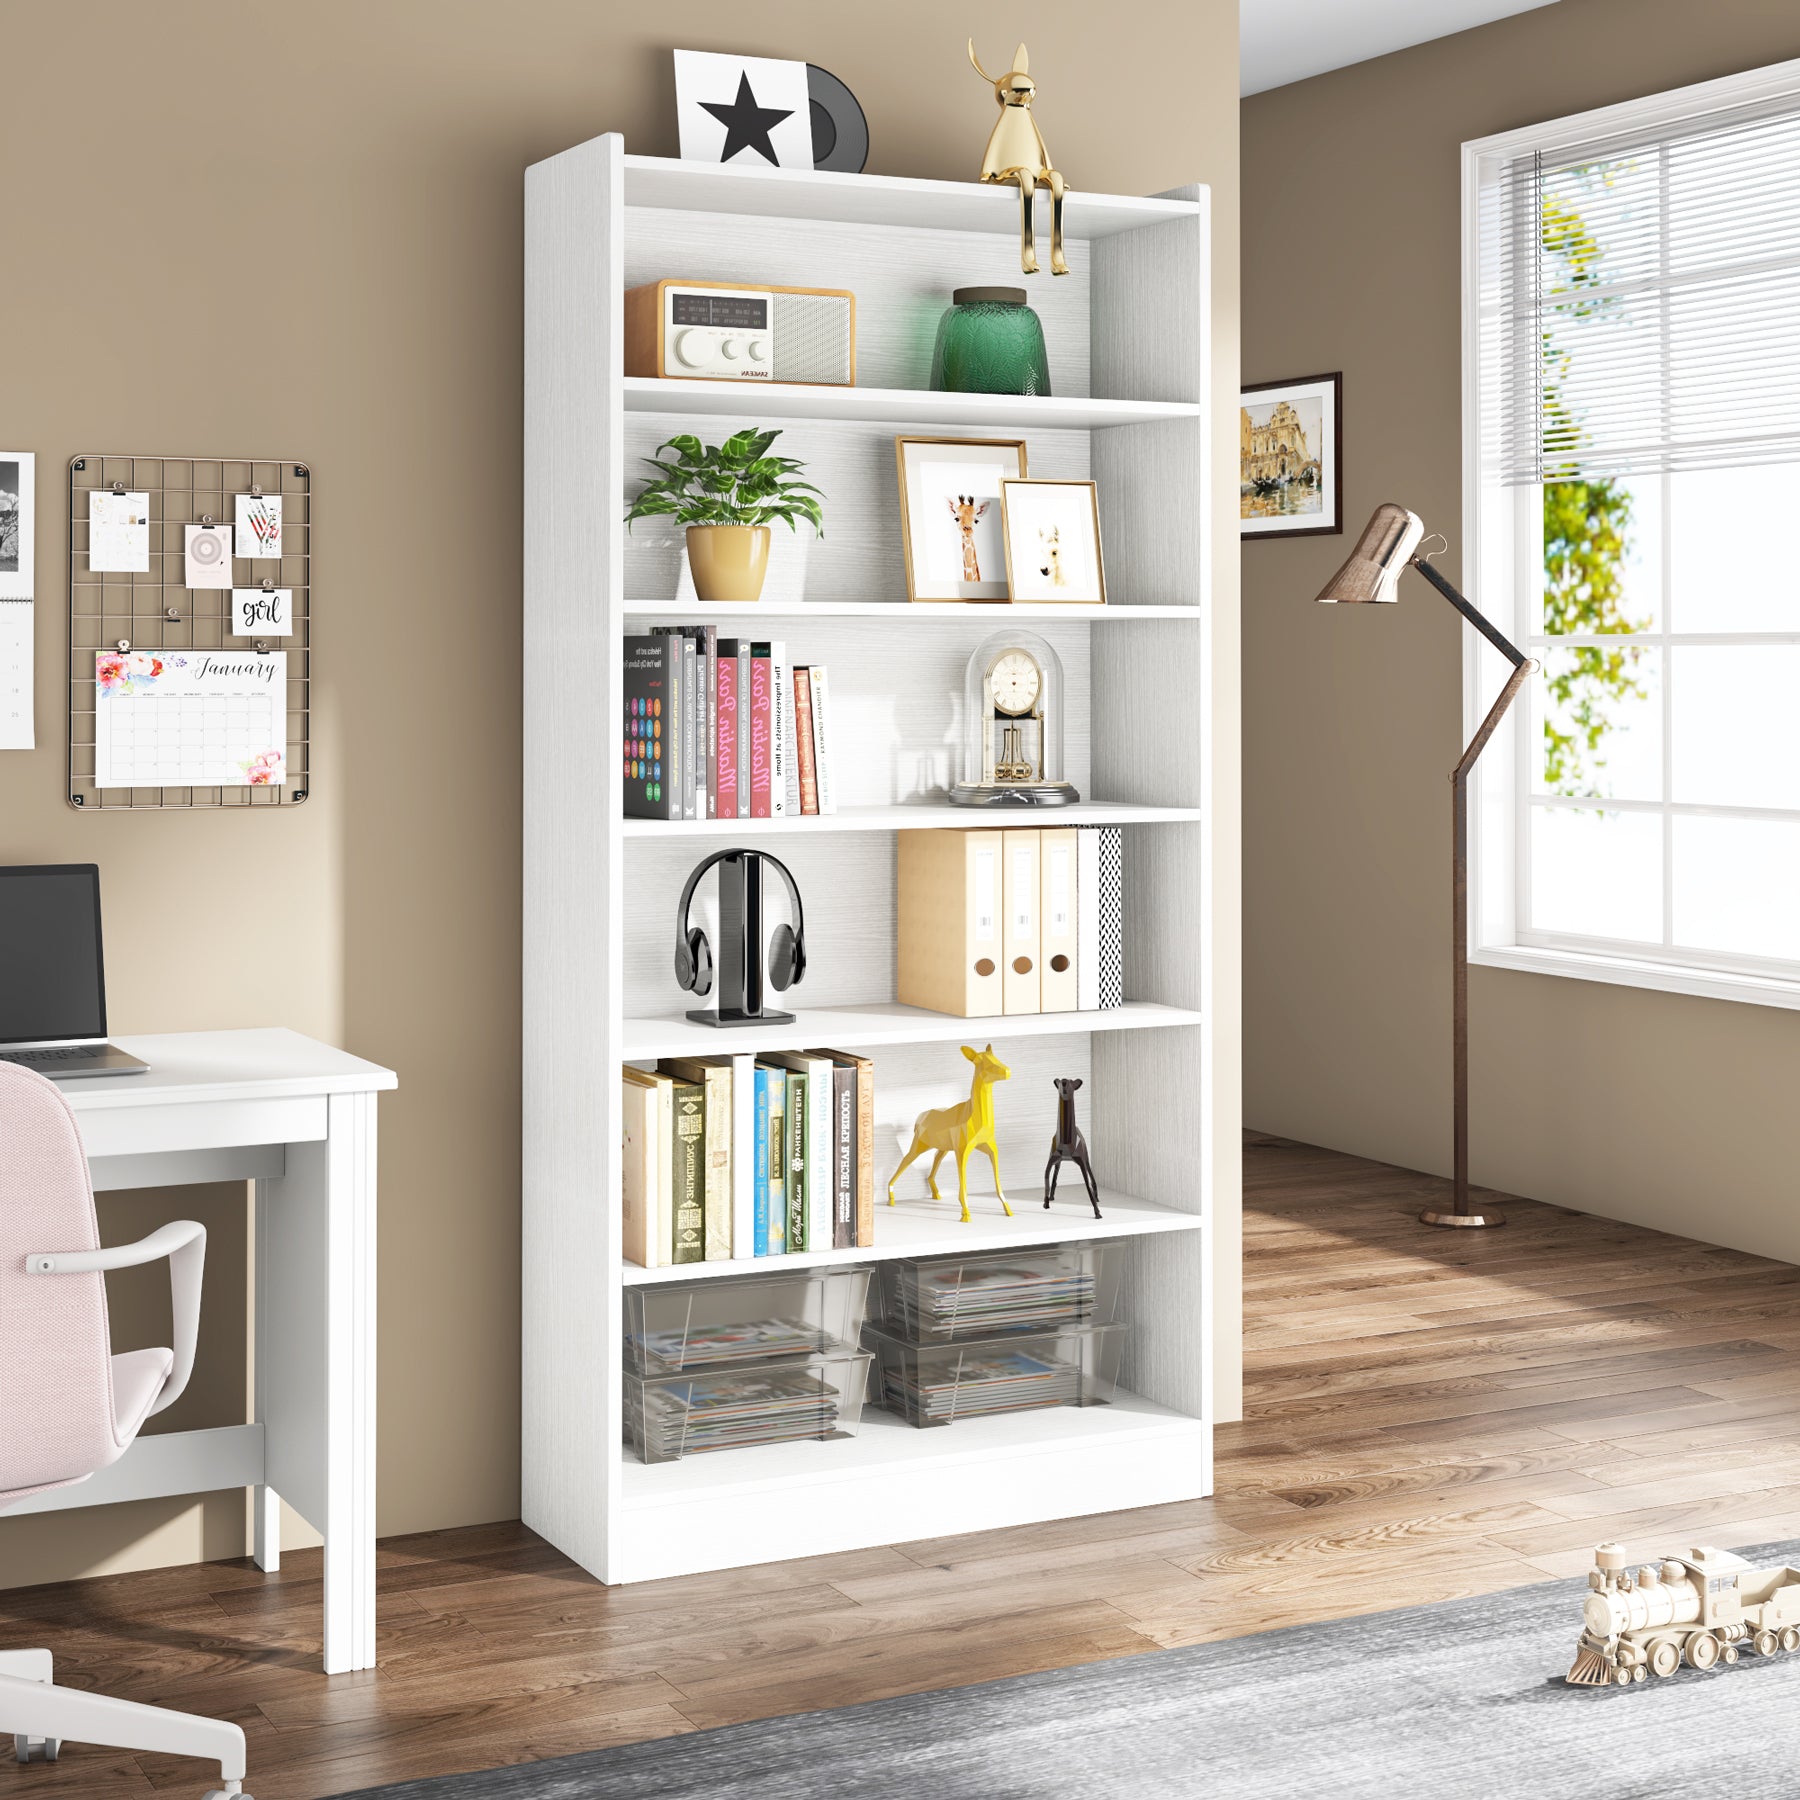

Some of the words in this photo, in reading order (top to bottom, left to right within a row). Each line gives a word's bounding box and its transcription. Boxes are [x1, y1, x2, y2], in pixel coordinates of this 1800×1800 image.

[243, 596, 282, 627] girl
[191, 657, 280, 683] January
[841, 1090, 851, 1143] КРЕПОСТЬ
[841, 1146, 850, 1189] ЛЕСНАЯ
